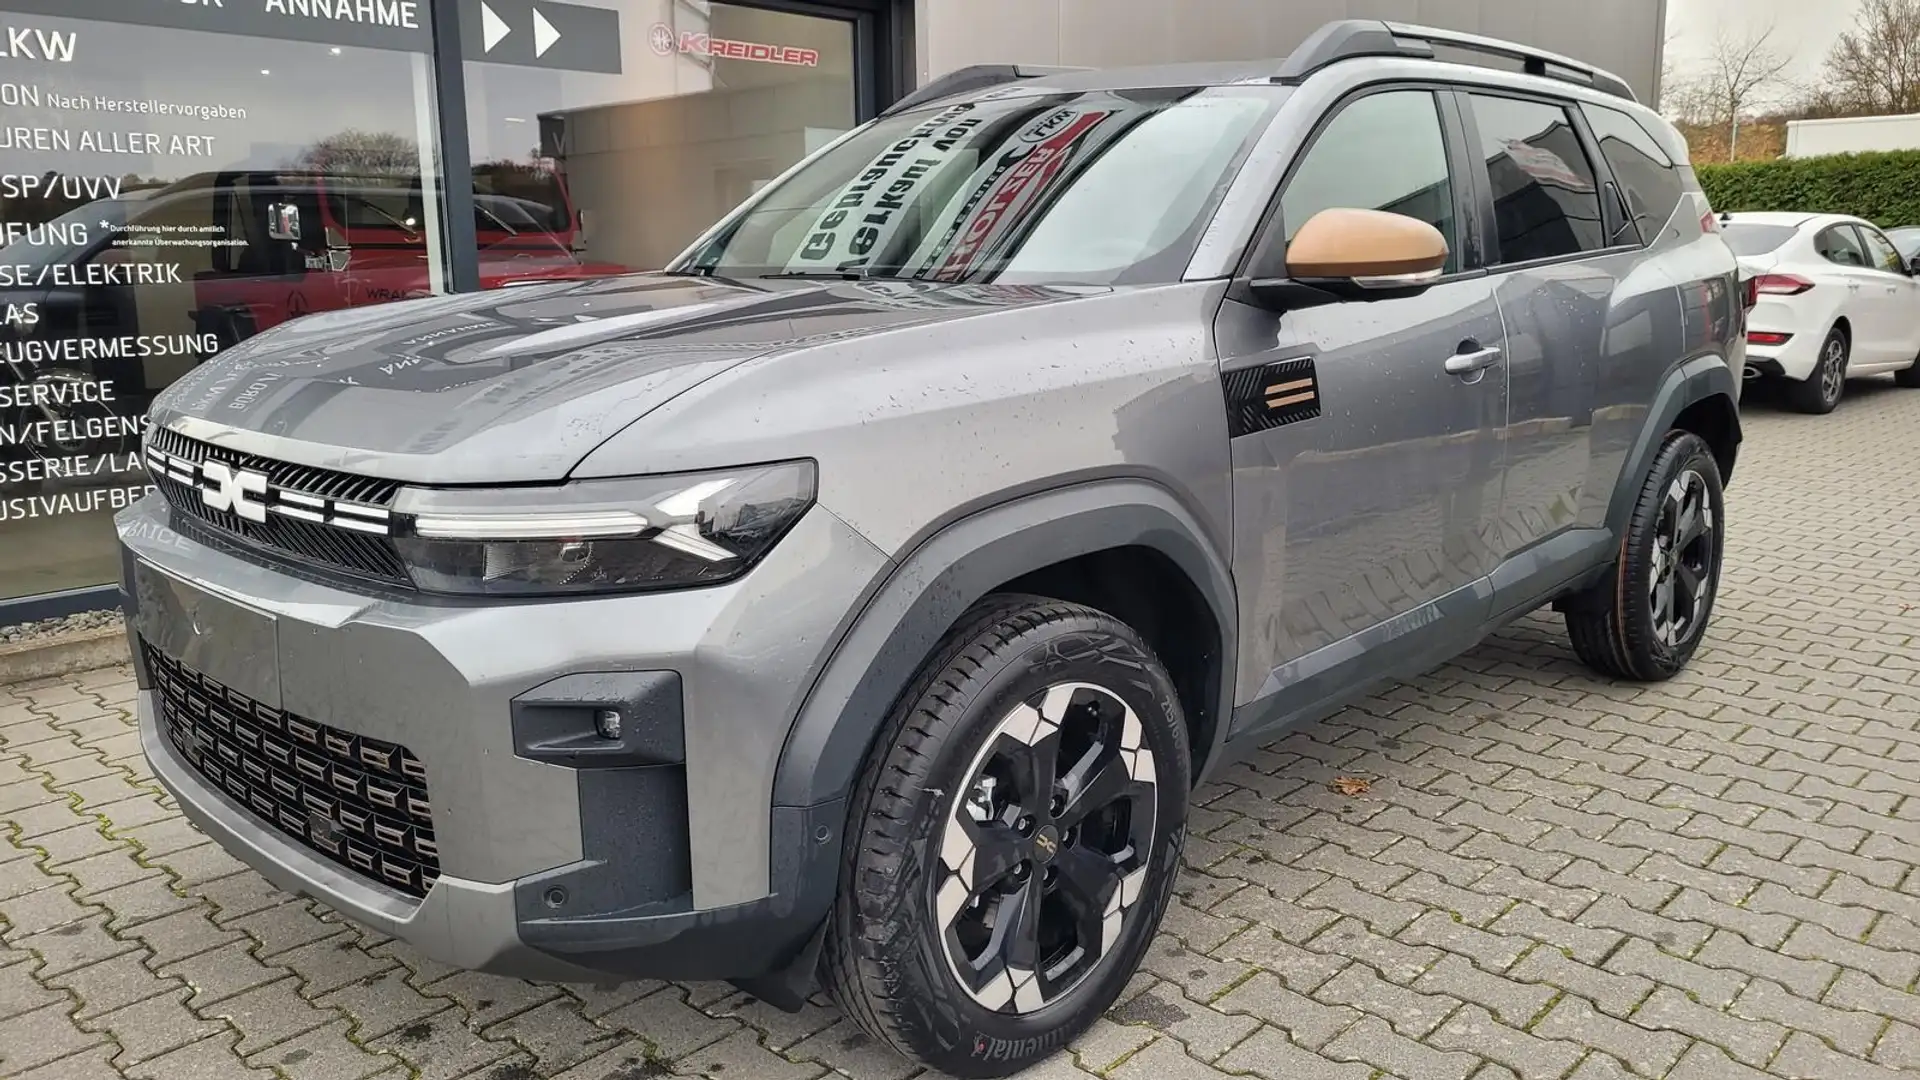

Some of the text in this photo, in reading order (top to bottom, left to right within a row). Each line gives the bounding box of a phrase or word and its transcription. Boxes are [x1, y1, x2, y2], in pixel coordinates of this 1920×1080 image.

[264, 0, 419, 29] ANNAHME
[679, 31, 819, 67] KREIDLER
[1, 83, 247, 120] ON Nach Herstellervorgaben
[79, 130, 161, 155] ALLER
[169, 134, 215, 157] ART
[2, 174, 121, 200] SP/UVV
[0, 222, 88, 246] FUNG
[161, 225, 177, 233] hier
[177, 225, 198, 233] durch
[0, 263, 182, 287] SE/ELEKTRIK
[0, 302, 39, 325] AS
[0, 380, 116, 408] SERVICE
